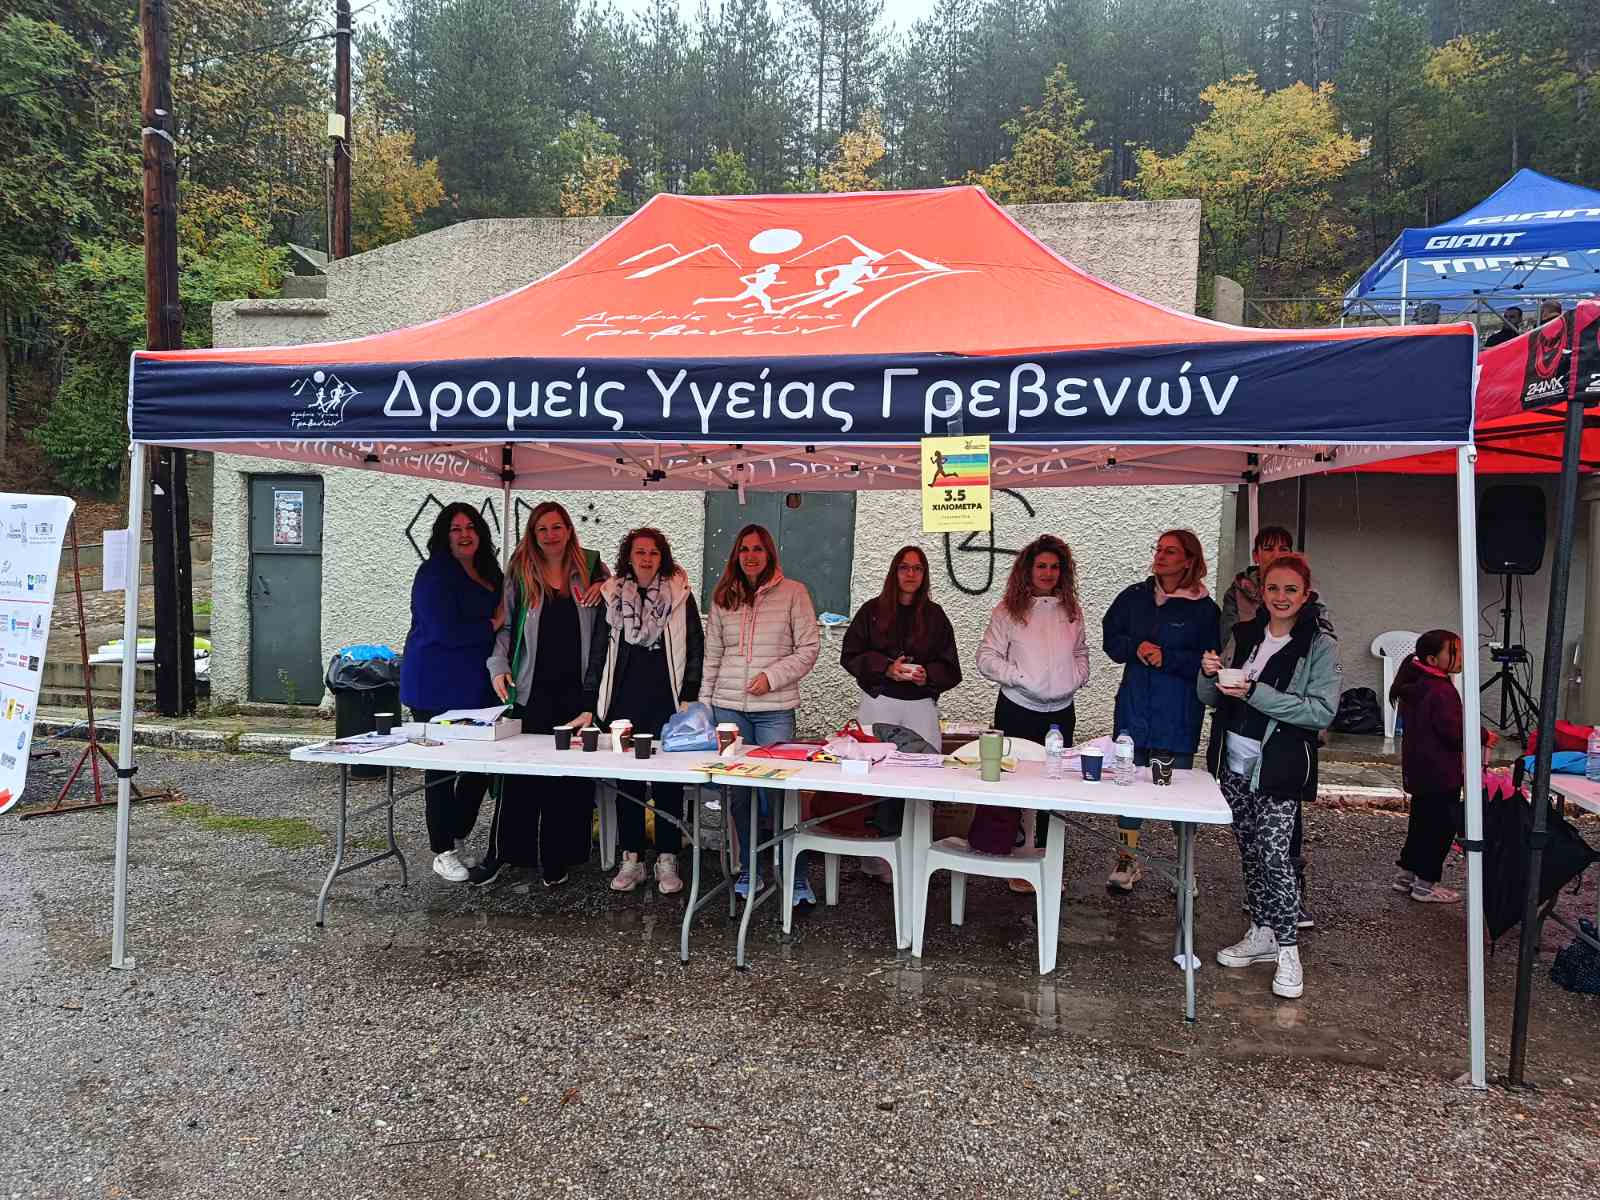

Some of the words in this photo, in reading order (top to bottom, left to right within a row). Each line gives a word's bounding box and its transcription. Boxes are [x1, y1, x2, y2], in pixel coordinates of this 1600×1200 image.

[1424, 232, 1526, 250] GIANT
[1526, 375, 1565, 396] 24MX
[383, 366, 626, 432] Δρομείς
[646, 367, 856, 434] Υγείας
[881, 361, 1240, 434] Γρεβενών
[944, 489, 966, 502] 3.5
[932, 502, 983, 511] ΧΙΛΙΟΜΕΤΡΑ
